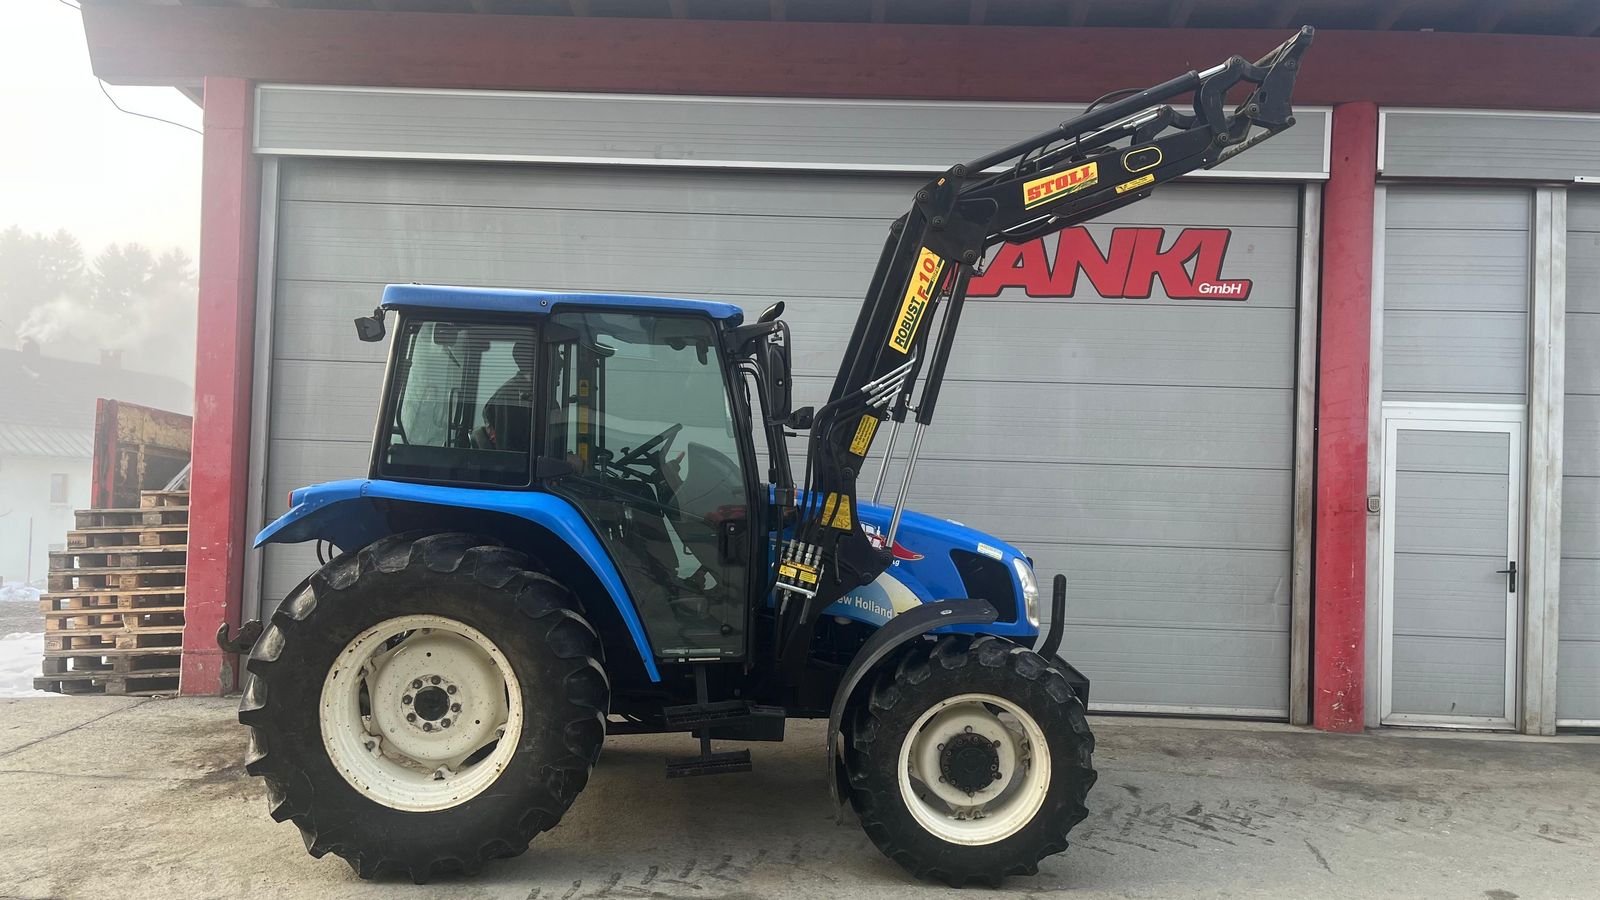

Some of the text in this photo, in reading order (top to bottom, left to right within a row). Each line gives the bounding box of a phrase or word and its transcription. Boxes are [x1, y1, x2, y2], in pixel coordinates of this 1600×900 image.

[941, 225, 1252, 300] ANKL
[1198, 282, 1242, 295] GmbH
[894, 296, 921, 348] ROBUST
[836, 595, 893, 619] ew Holland
